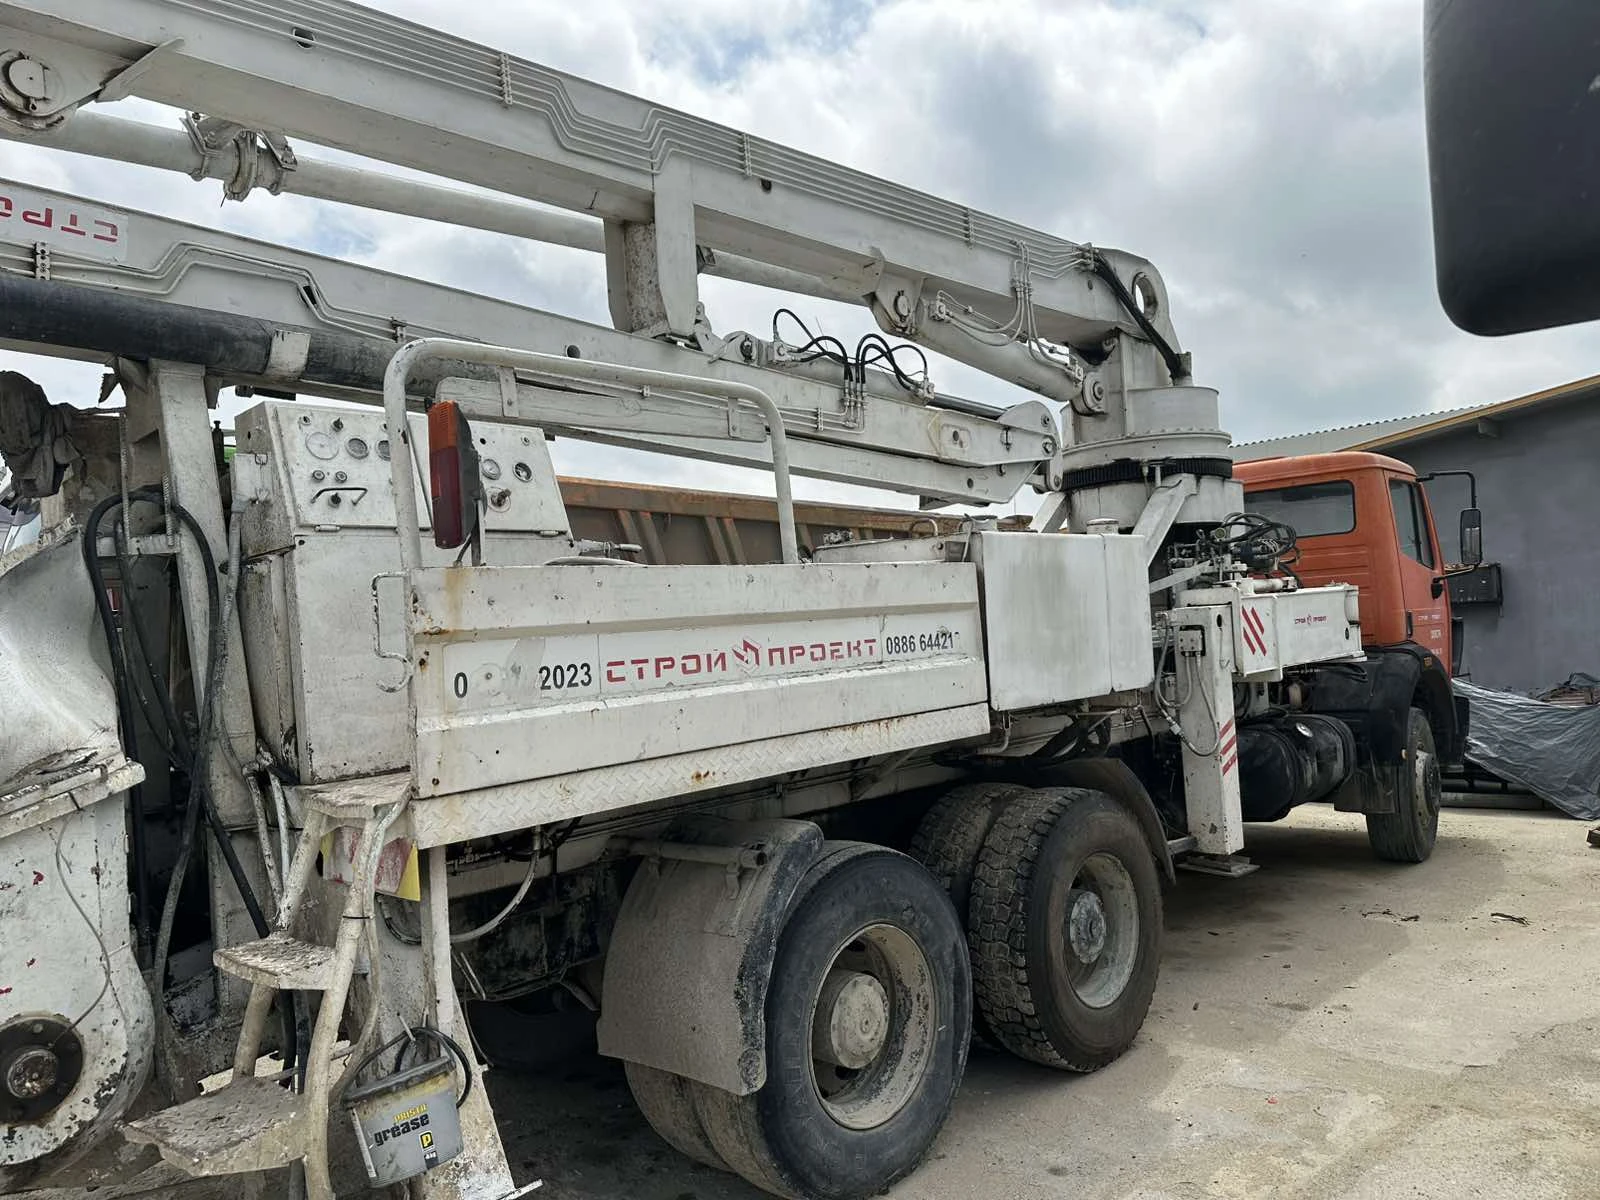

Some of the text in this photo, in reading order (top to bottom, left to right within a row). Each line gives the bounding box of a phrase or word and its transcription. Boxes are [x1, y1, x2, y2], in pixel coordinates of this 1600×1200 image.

[886, 631, 960, 655] 0886 64421
[606, 638, 877, 683] СТРОЙ ПРОЕКТ
[539, 662, 592, 690] 2023
[374, 1113, 430, 1146] grease
